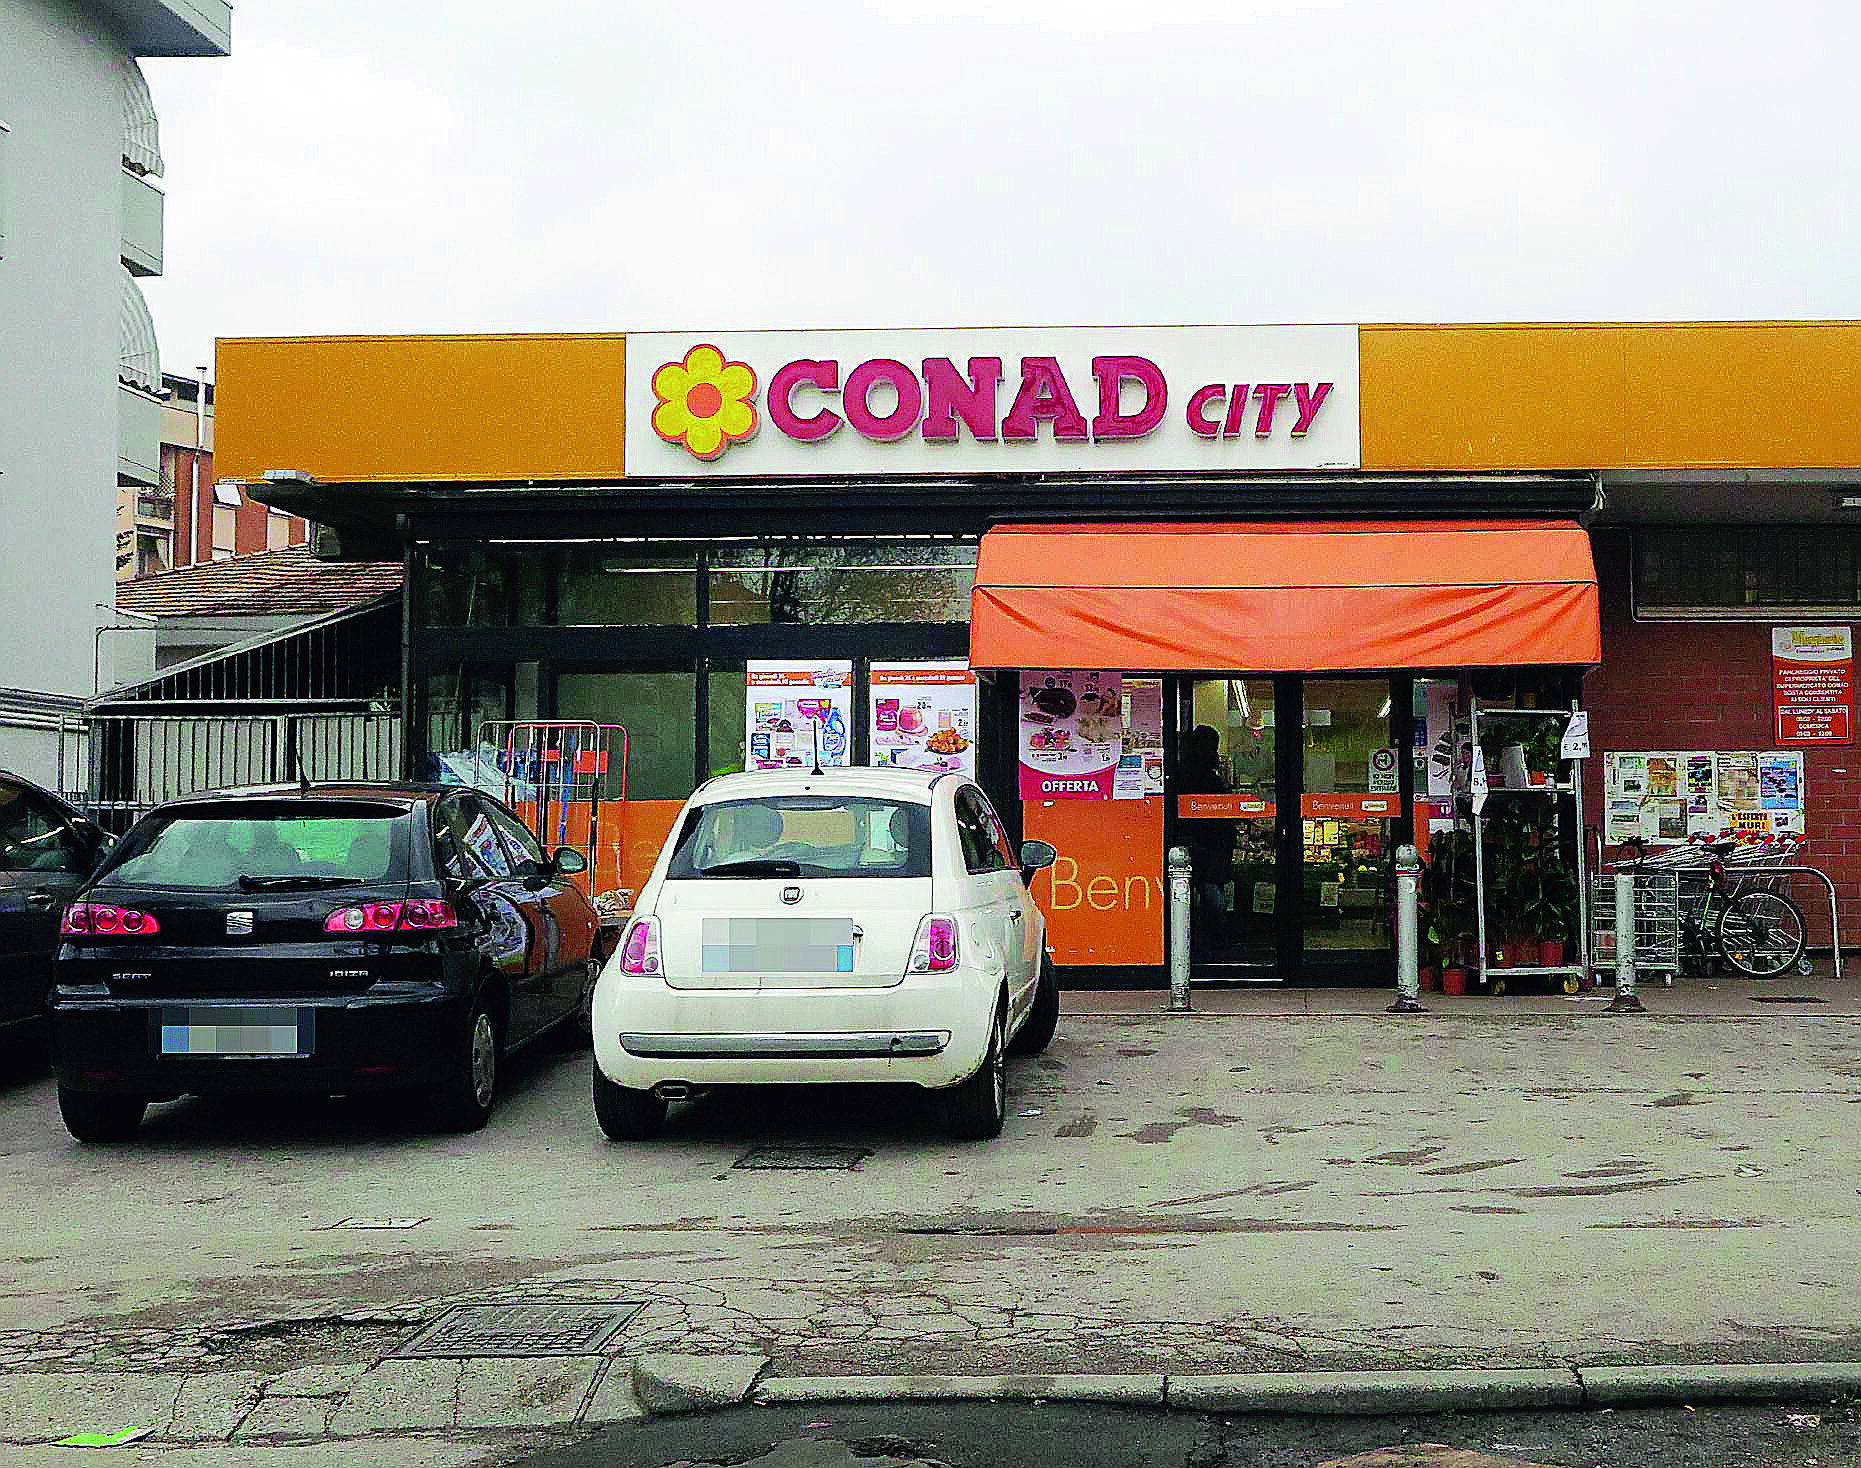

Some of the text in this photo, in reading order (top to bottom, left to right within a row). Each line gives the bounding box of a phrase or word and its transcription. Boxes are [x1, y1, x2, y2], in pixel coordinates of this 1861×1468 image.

[767, 356, 1333, 443] CONAD CITY
[1041, 780, 1100, 793] OFFERTA
